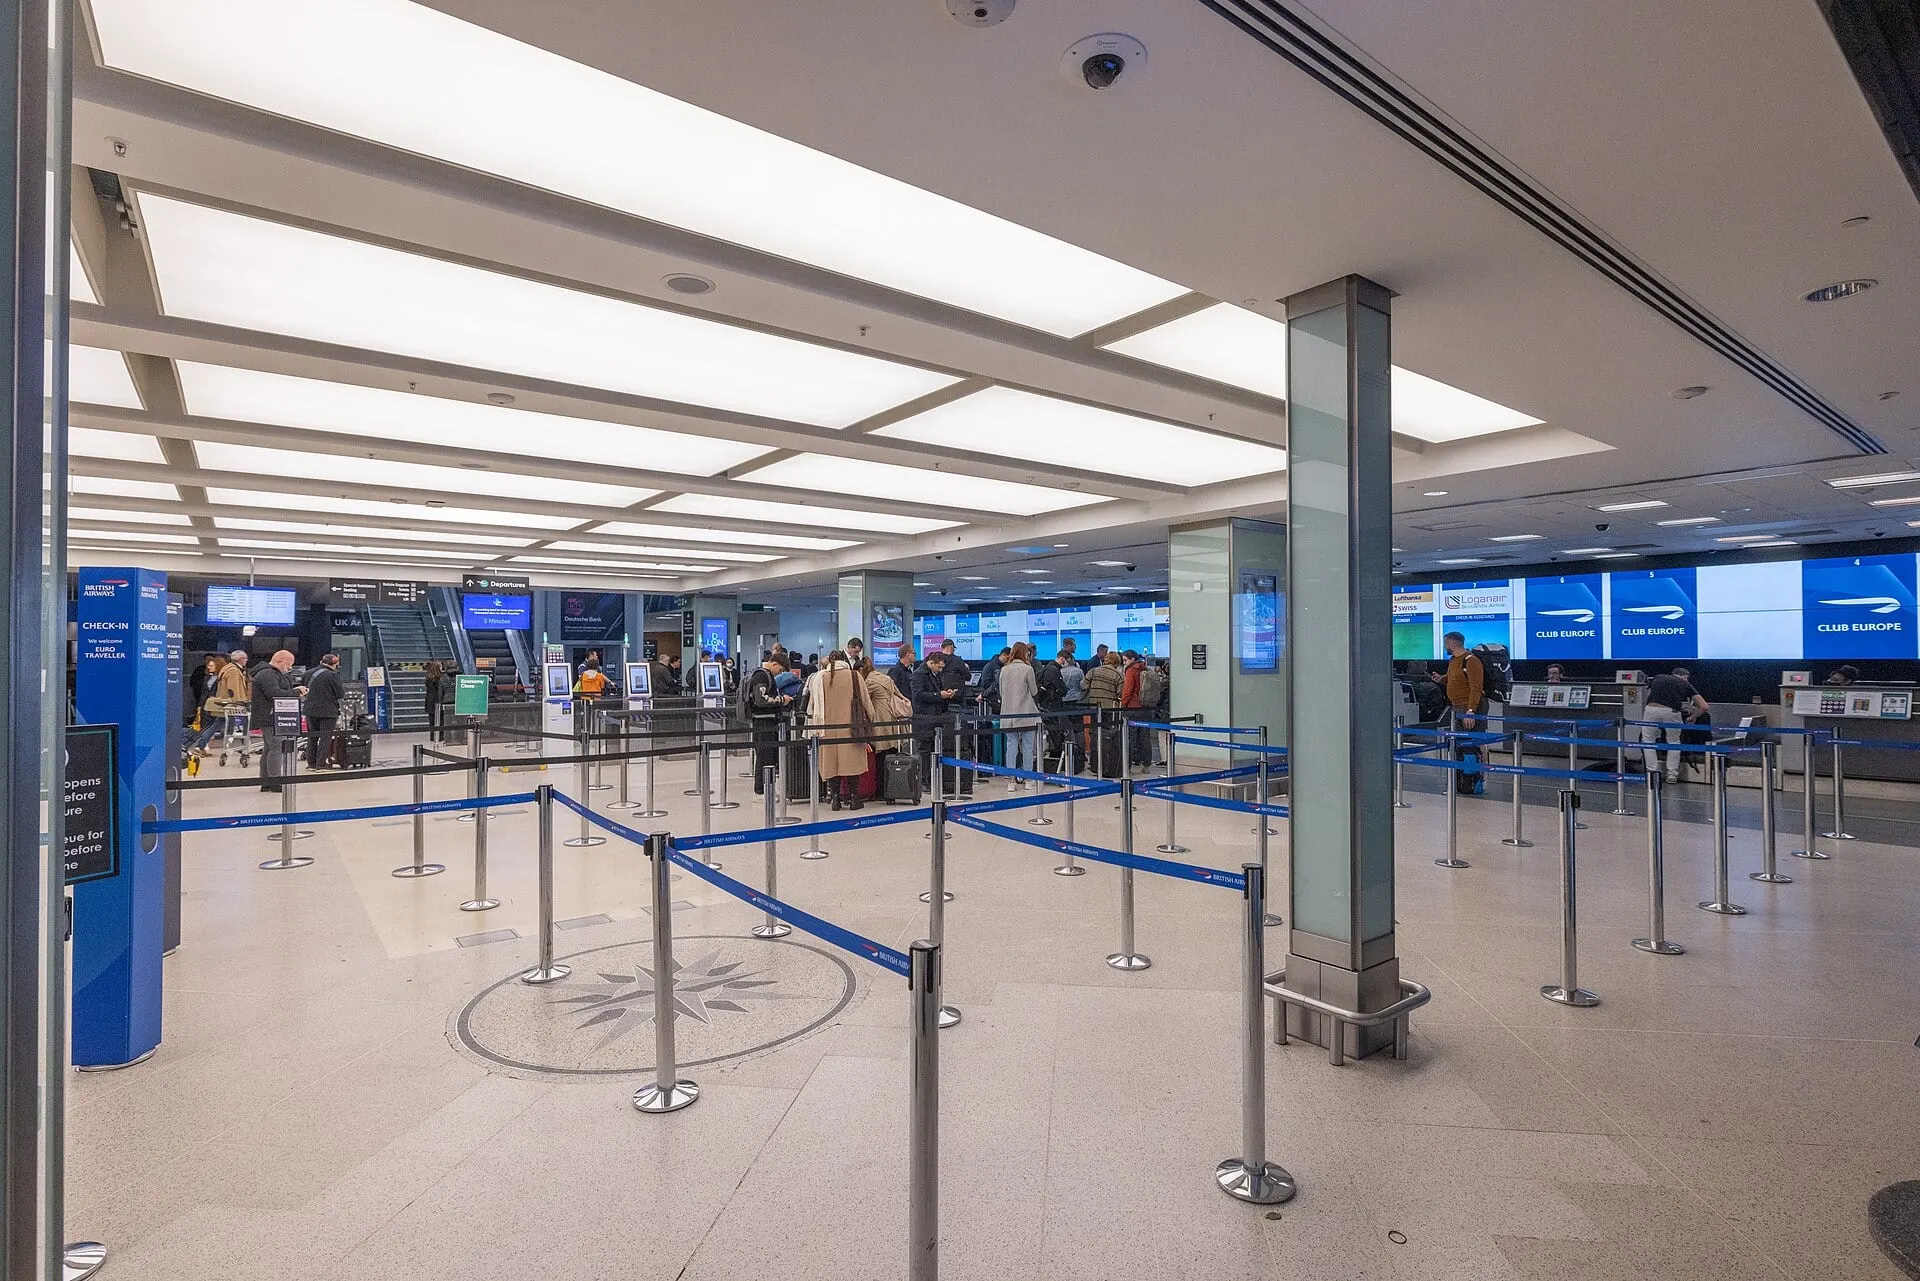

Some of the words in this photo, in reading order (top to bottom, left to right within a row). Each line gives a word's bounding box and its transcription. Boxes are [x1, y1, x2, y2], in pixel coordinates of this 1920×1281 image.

[1462, 595, 1506, 605] Loganair
[64, 778, 101, 790] opens
[88, 830, 104, 840] for
[1213, 874, 1233, 883] BRITISH
[880, 951, 898, 966] BRITISH
